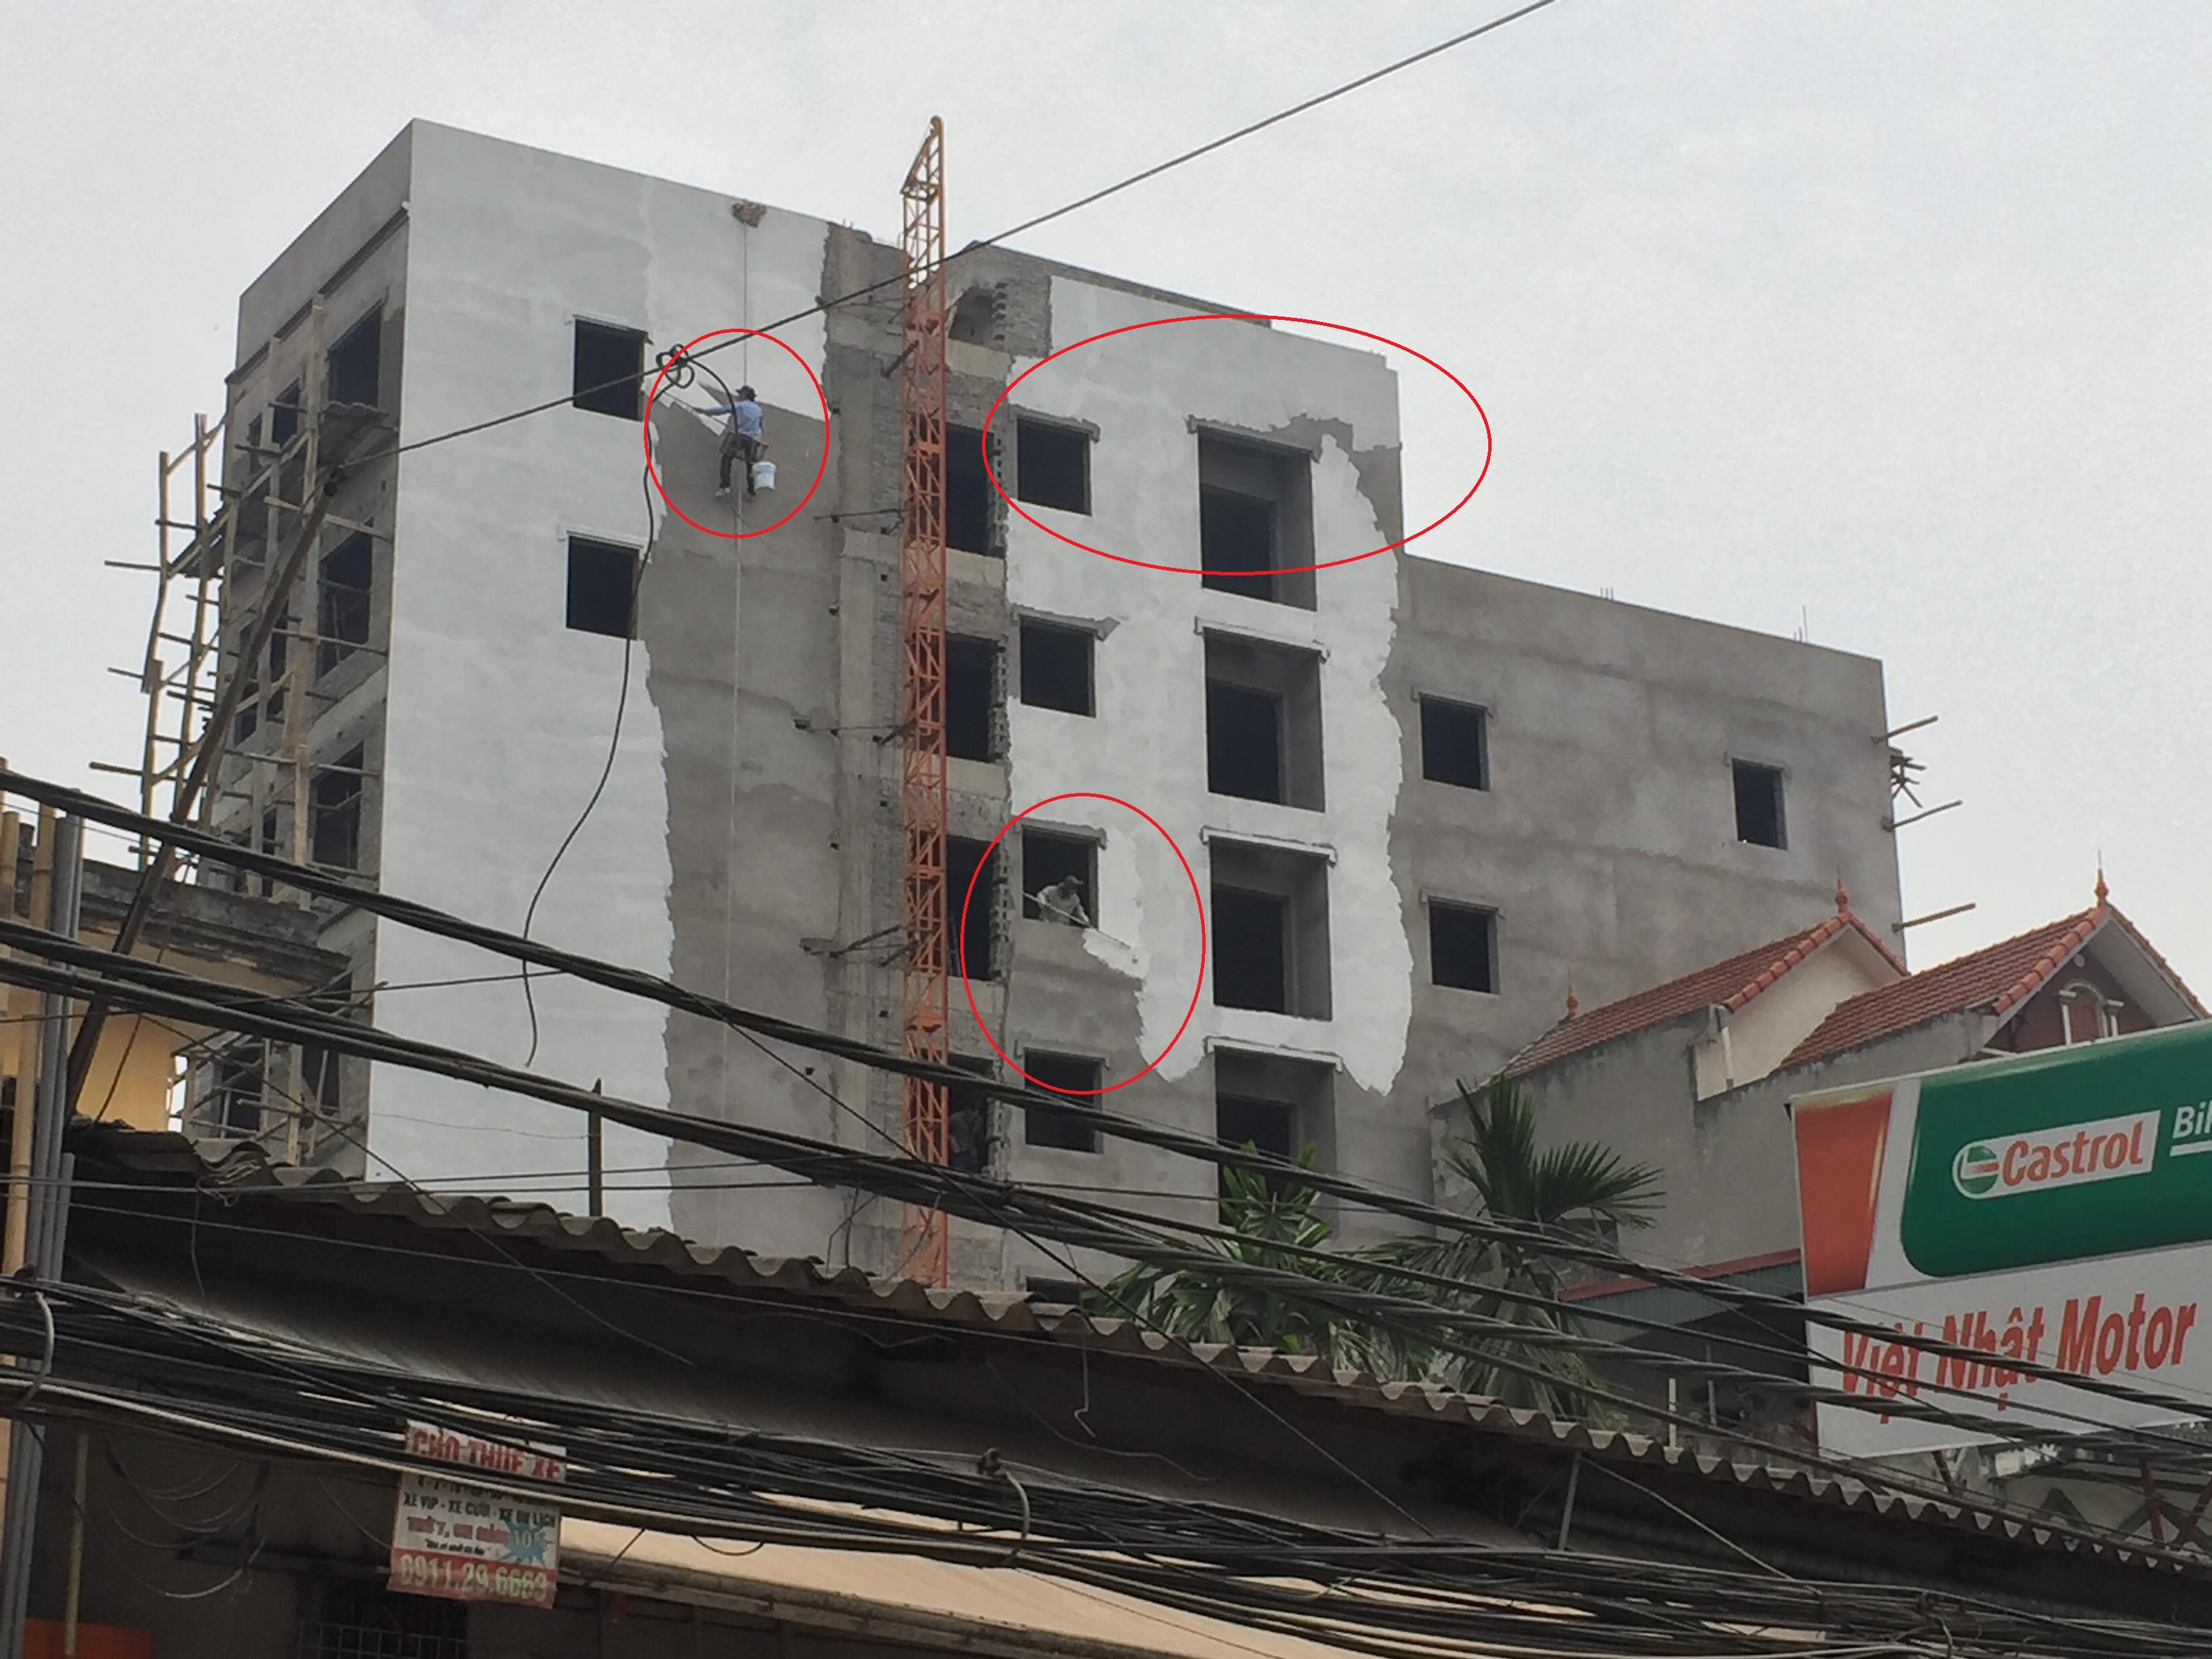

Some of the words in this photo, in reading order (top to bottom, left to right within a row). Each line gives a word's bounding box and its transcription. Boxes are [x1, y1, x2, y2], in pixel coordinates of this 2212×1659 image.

[2002, 1120, 2144, 1187] Castrol
[1936, 1307, 2045, 1411] Nhật
[2055, 1293, 2196, 1376] Motor
